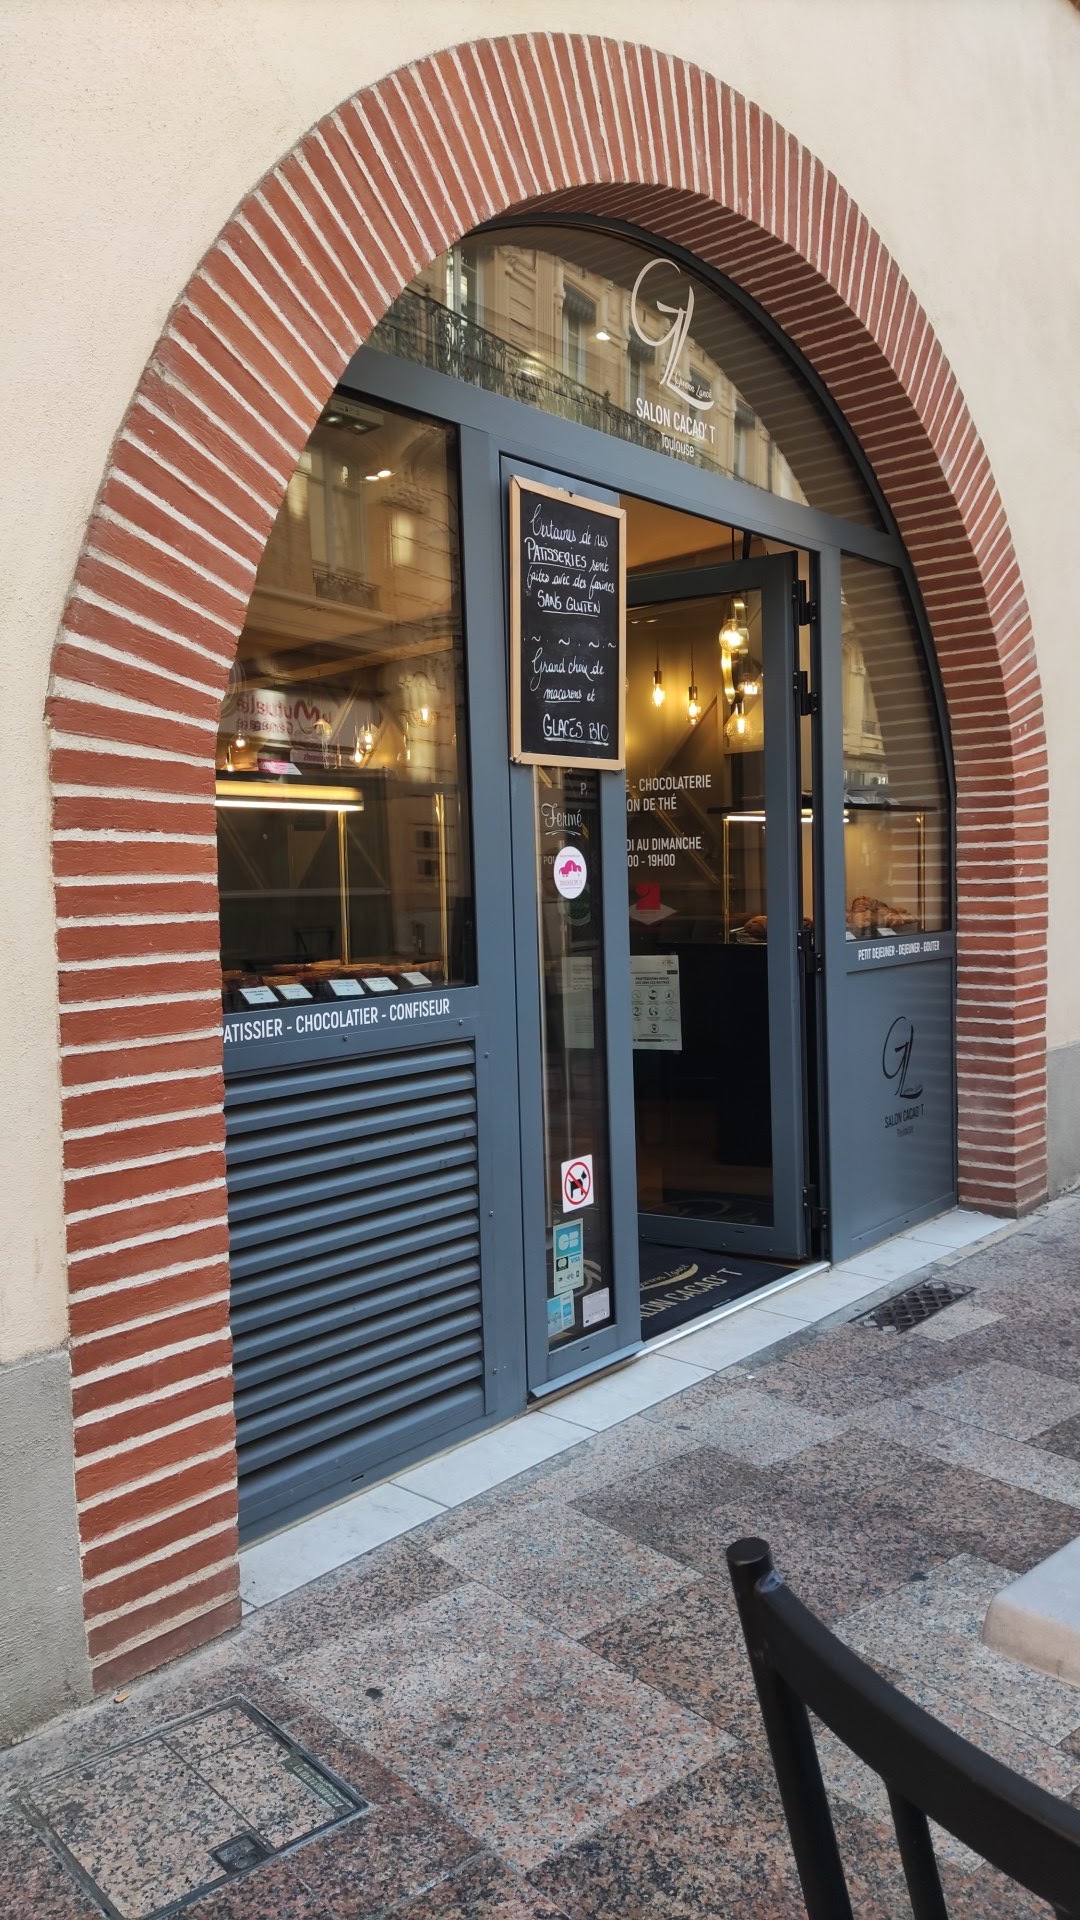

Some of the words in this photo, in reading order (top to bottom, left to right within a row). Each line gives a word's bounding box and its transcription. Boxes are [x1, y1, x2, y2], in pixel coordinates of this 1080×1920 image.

[635, 397, 671, 428] SALON
[660, 432, 695, 458] Toulouse
[578, 524, 591, 545] de
[594, 534, 608, 548] nos
[588, 557, 610, 573] sont
[526, 565, 550, 589] faites
[551, 572, 570, 586] avec
[572, 573, 587, 589] des
[588, 574, 615, 600] farines
[537, 589, 562, 610] SANS
[565, 596, 601, 614] GLUTEN
[530, 646, 566, 692] Grand
[567, 656, 594, 682] choix
[590, 659, 605, 675] de
[543, 687, 583, 701] macarons
[586, 687, 596, 702] et
[588, 722, 610, 741] BIO
[639, 774, 712, 792] CHOCOLATERIE
[626, 798, 641, 812] ON
[643, 797, 656, 811] DE
[658, 793, 677, 811] THÉ
[541, 802, 583, 828] Fermé
[636, 837, 649, 851] AU
[651, 836, 702, 851] DIMANCHE
[627, 855, 639, 867] 00
[647, 854, 676, 867] 19H00
[858, 948, 872, 961] PETIT
[872, 945, 896, 960] DEJEUNER
[898, 942, 921, 956] DEJEUNER
[923, 940, 940, 952] GOUTER
[223, 1018, 283, 1044] ATISSIER
[295, 1006, 379, 1034] CHOCOLATIER
[389, 998, 451, 1022] CONFISEUR
[884, 1111, 903, 1128] SALON
[570, 1255, 581, 1265] VISA
